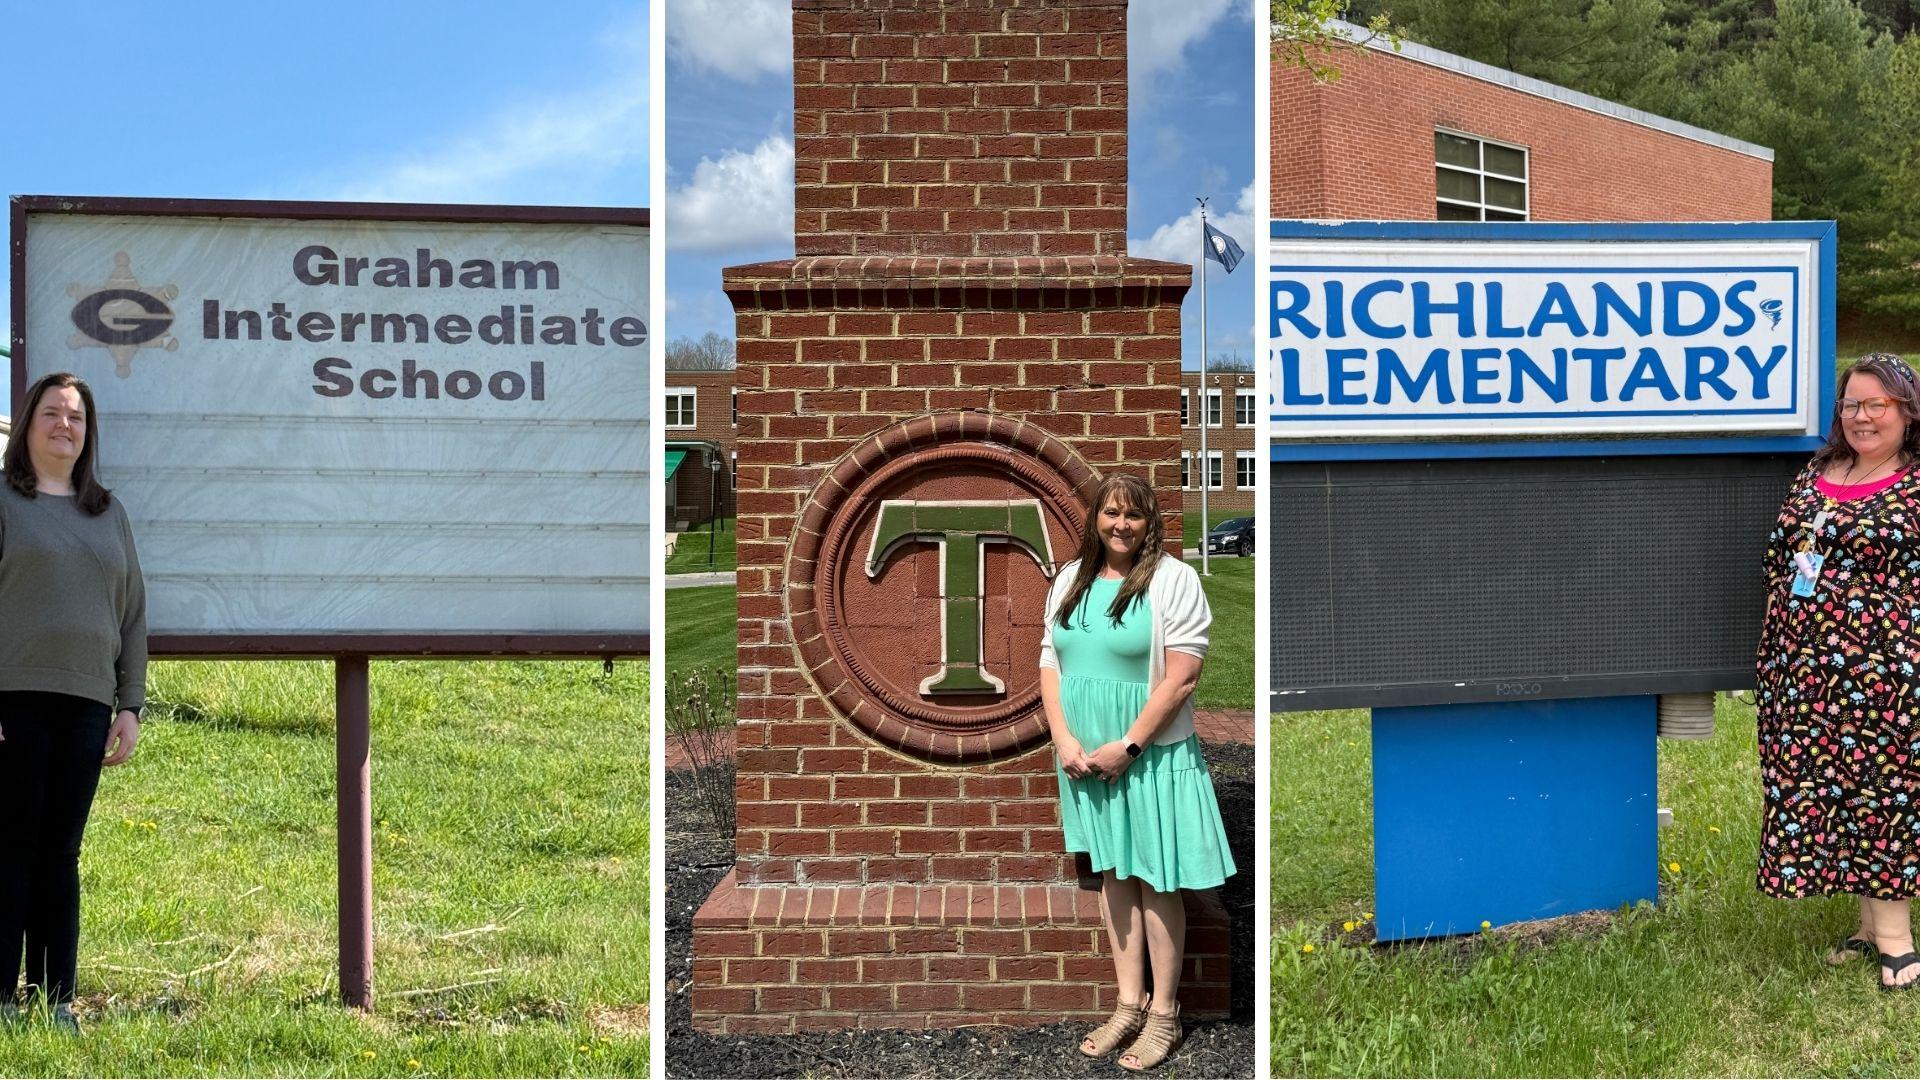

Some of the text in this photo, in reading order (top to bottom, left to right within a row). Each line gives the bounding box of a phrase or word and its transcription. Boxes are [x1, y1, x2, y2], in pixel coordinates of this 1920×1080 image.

[292, 245, 560, 290] Graham
[70, 288, 175, 346] G
[202, 300, 648, 347] Intermediate
[1270, 279, 1757, 339] RICHLANDS
[312, 357, 546, 401] School
[1270, 344, 1788, 406] LEMENTARY
[1841, 525, 1867, 545] SCHOOL
[865, 499, 1057, 695] T
[1849, 659, 1878, 677] SCHOOL
[1784, 788, 1809, 809] SCHOOL
[1845, 795, 1870, 808] SCHOOL
